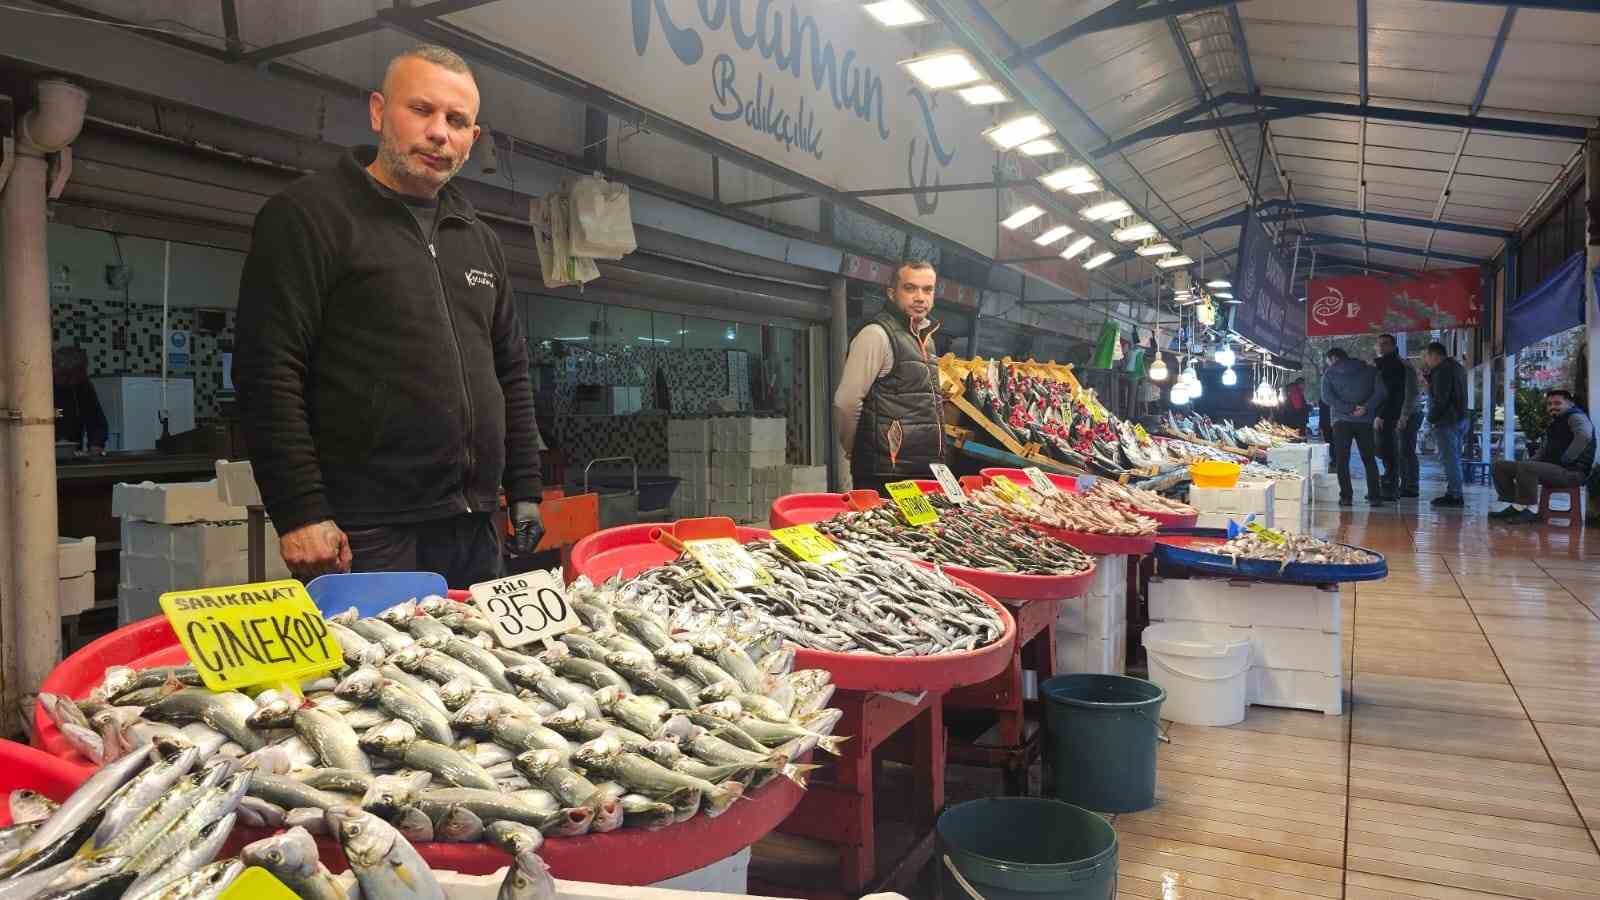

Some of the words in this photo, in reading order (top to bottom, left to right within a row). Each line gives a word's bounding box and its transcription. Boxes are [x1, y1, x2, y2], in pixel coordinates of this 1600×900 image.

[175, 587, 297, 611] SARIKANAT
[487, 588, 567, 635] 350
[187, 611, 329, 681] ÇİNEKOP
